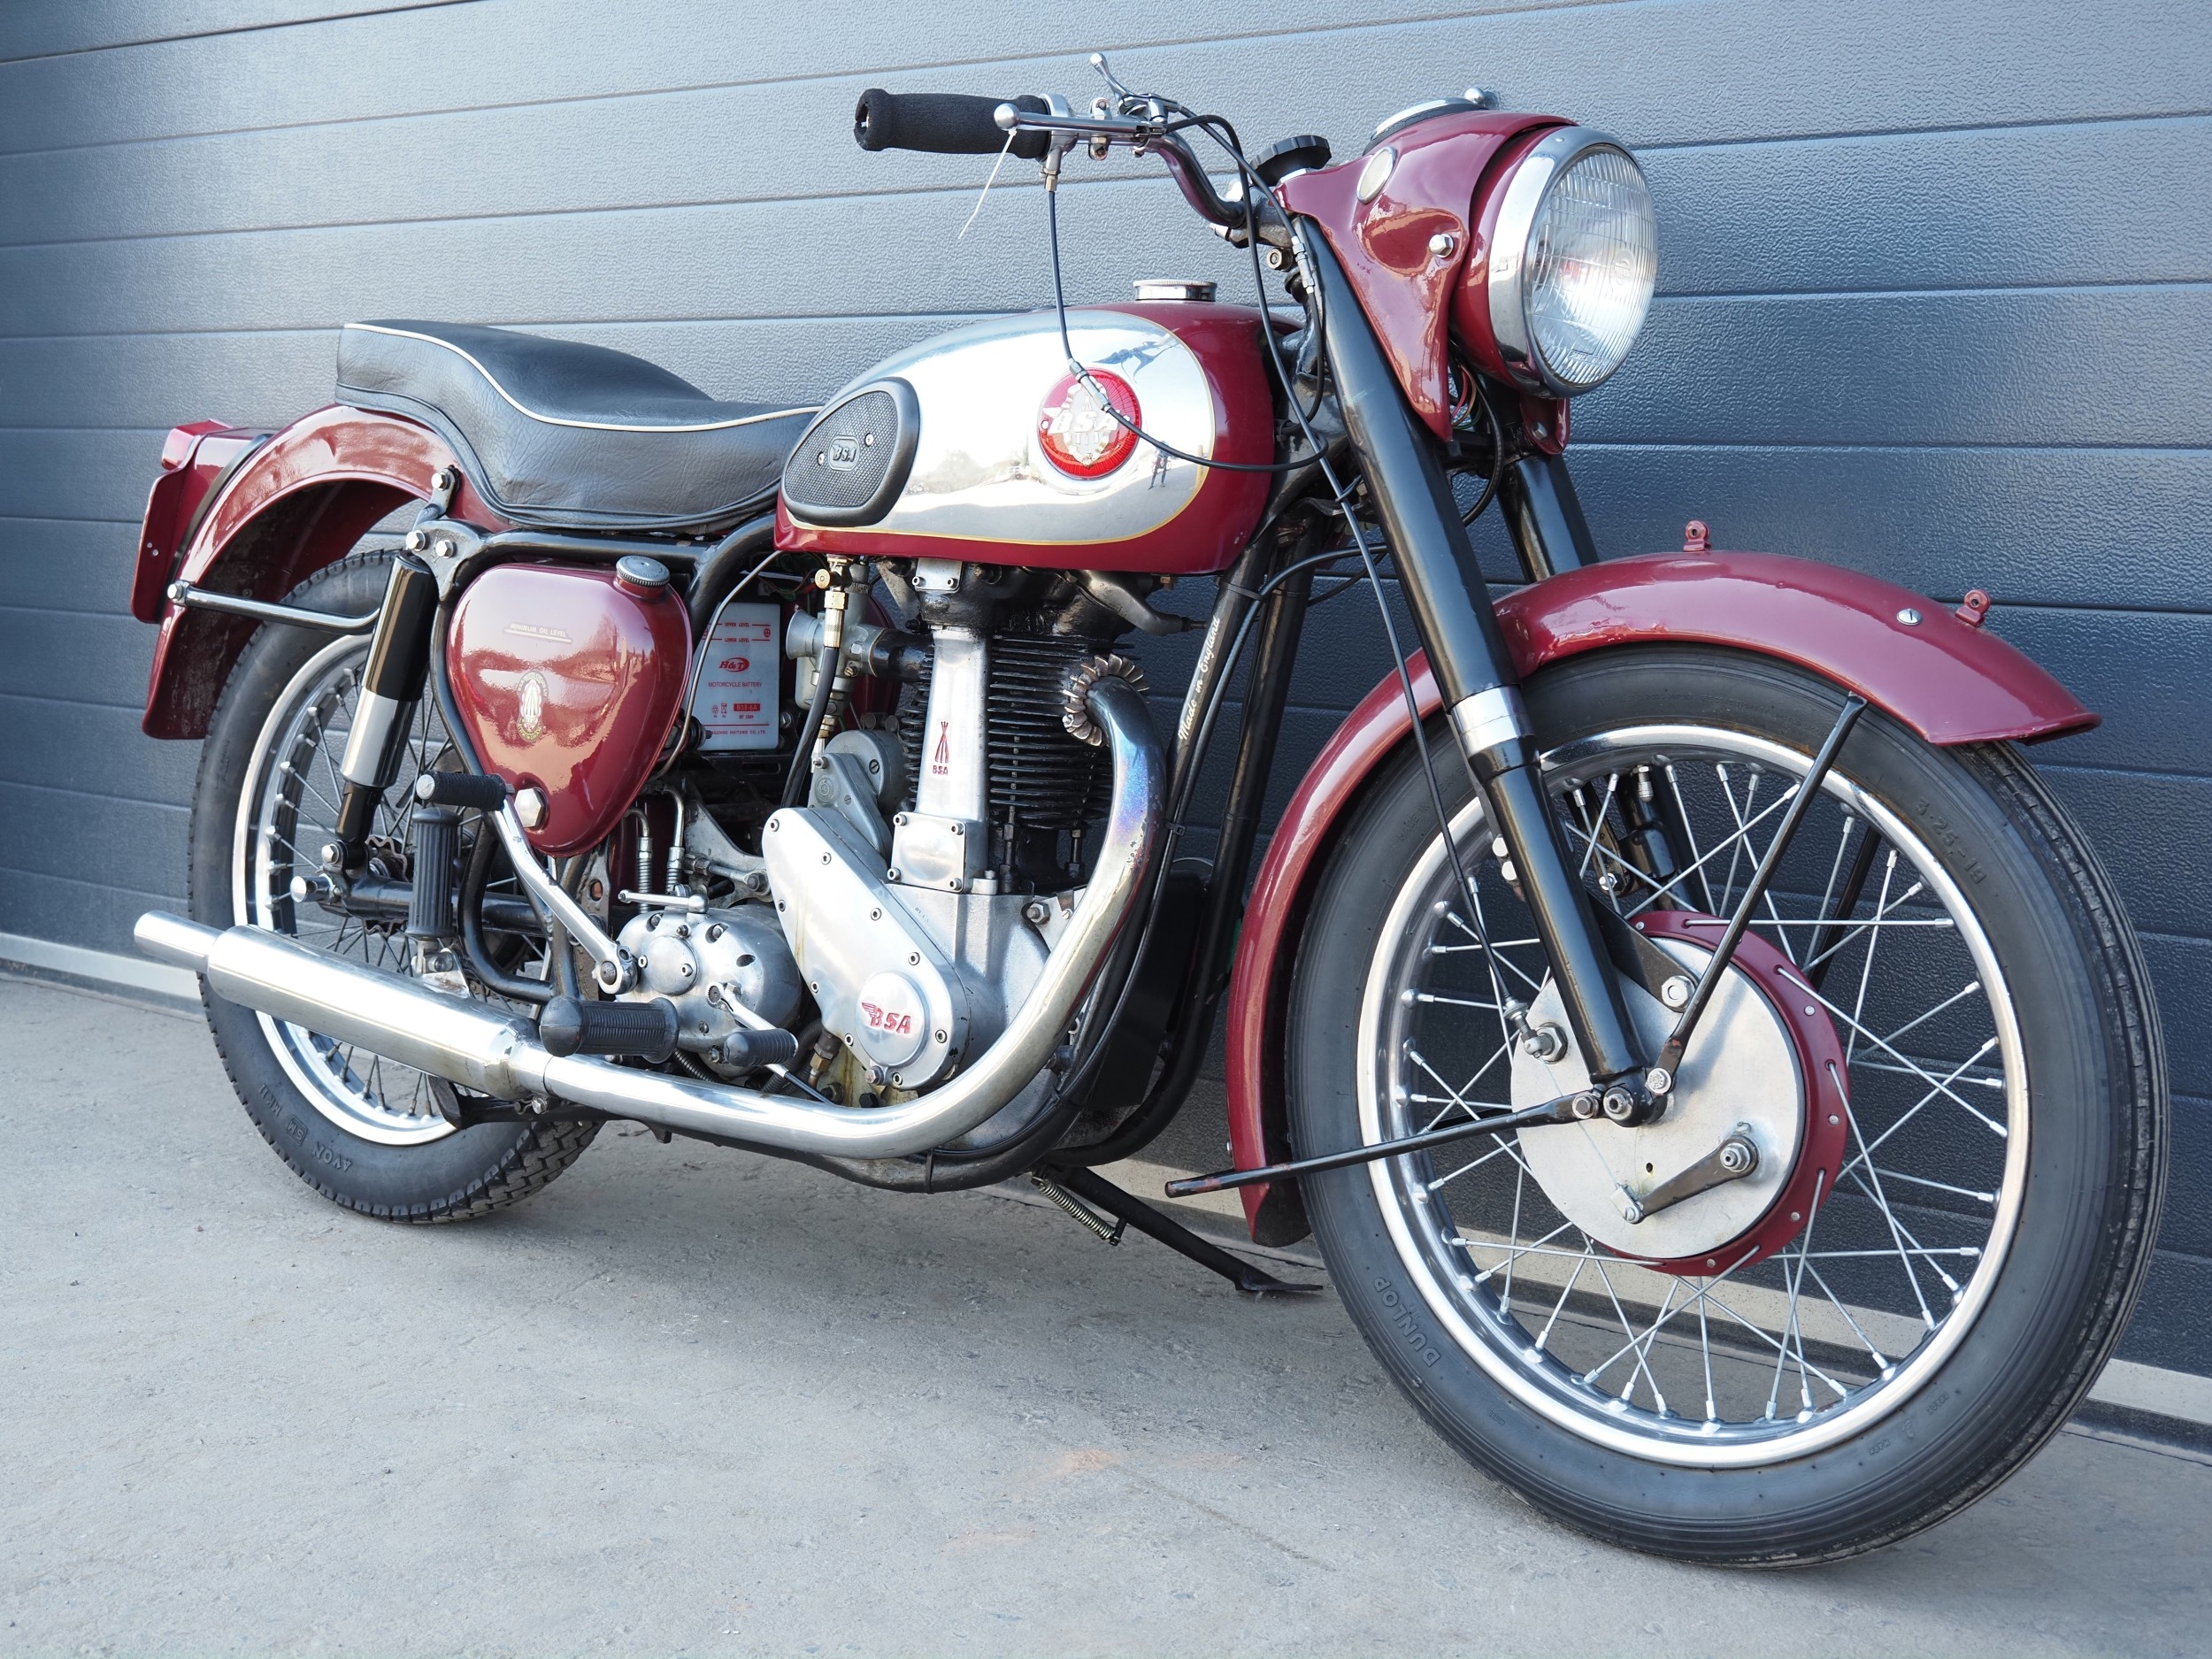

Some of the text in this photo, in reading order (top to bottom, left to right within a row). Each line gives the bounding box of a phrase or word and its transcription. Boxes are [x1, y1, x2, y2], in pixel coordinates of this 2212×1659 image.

[1045, 409, 1120, 434] BSA
[833, 444, 856, 462] BSA
[510, 623, 537, 633] MINIMUM
[550, 629, 566, 638] LEVEL
[1178, 615, 1220, 741] Made in England
[933, 764, 949, 776] BSA
[862, 1002, 911, 1034] BSA
[312, 1141, 353, 1172] AVON
[1373, 1277, 1441, 1367] DUNLOP
